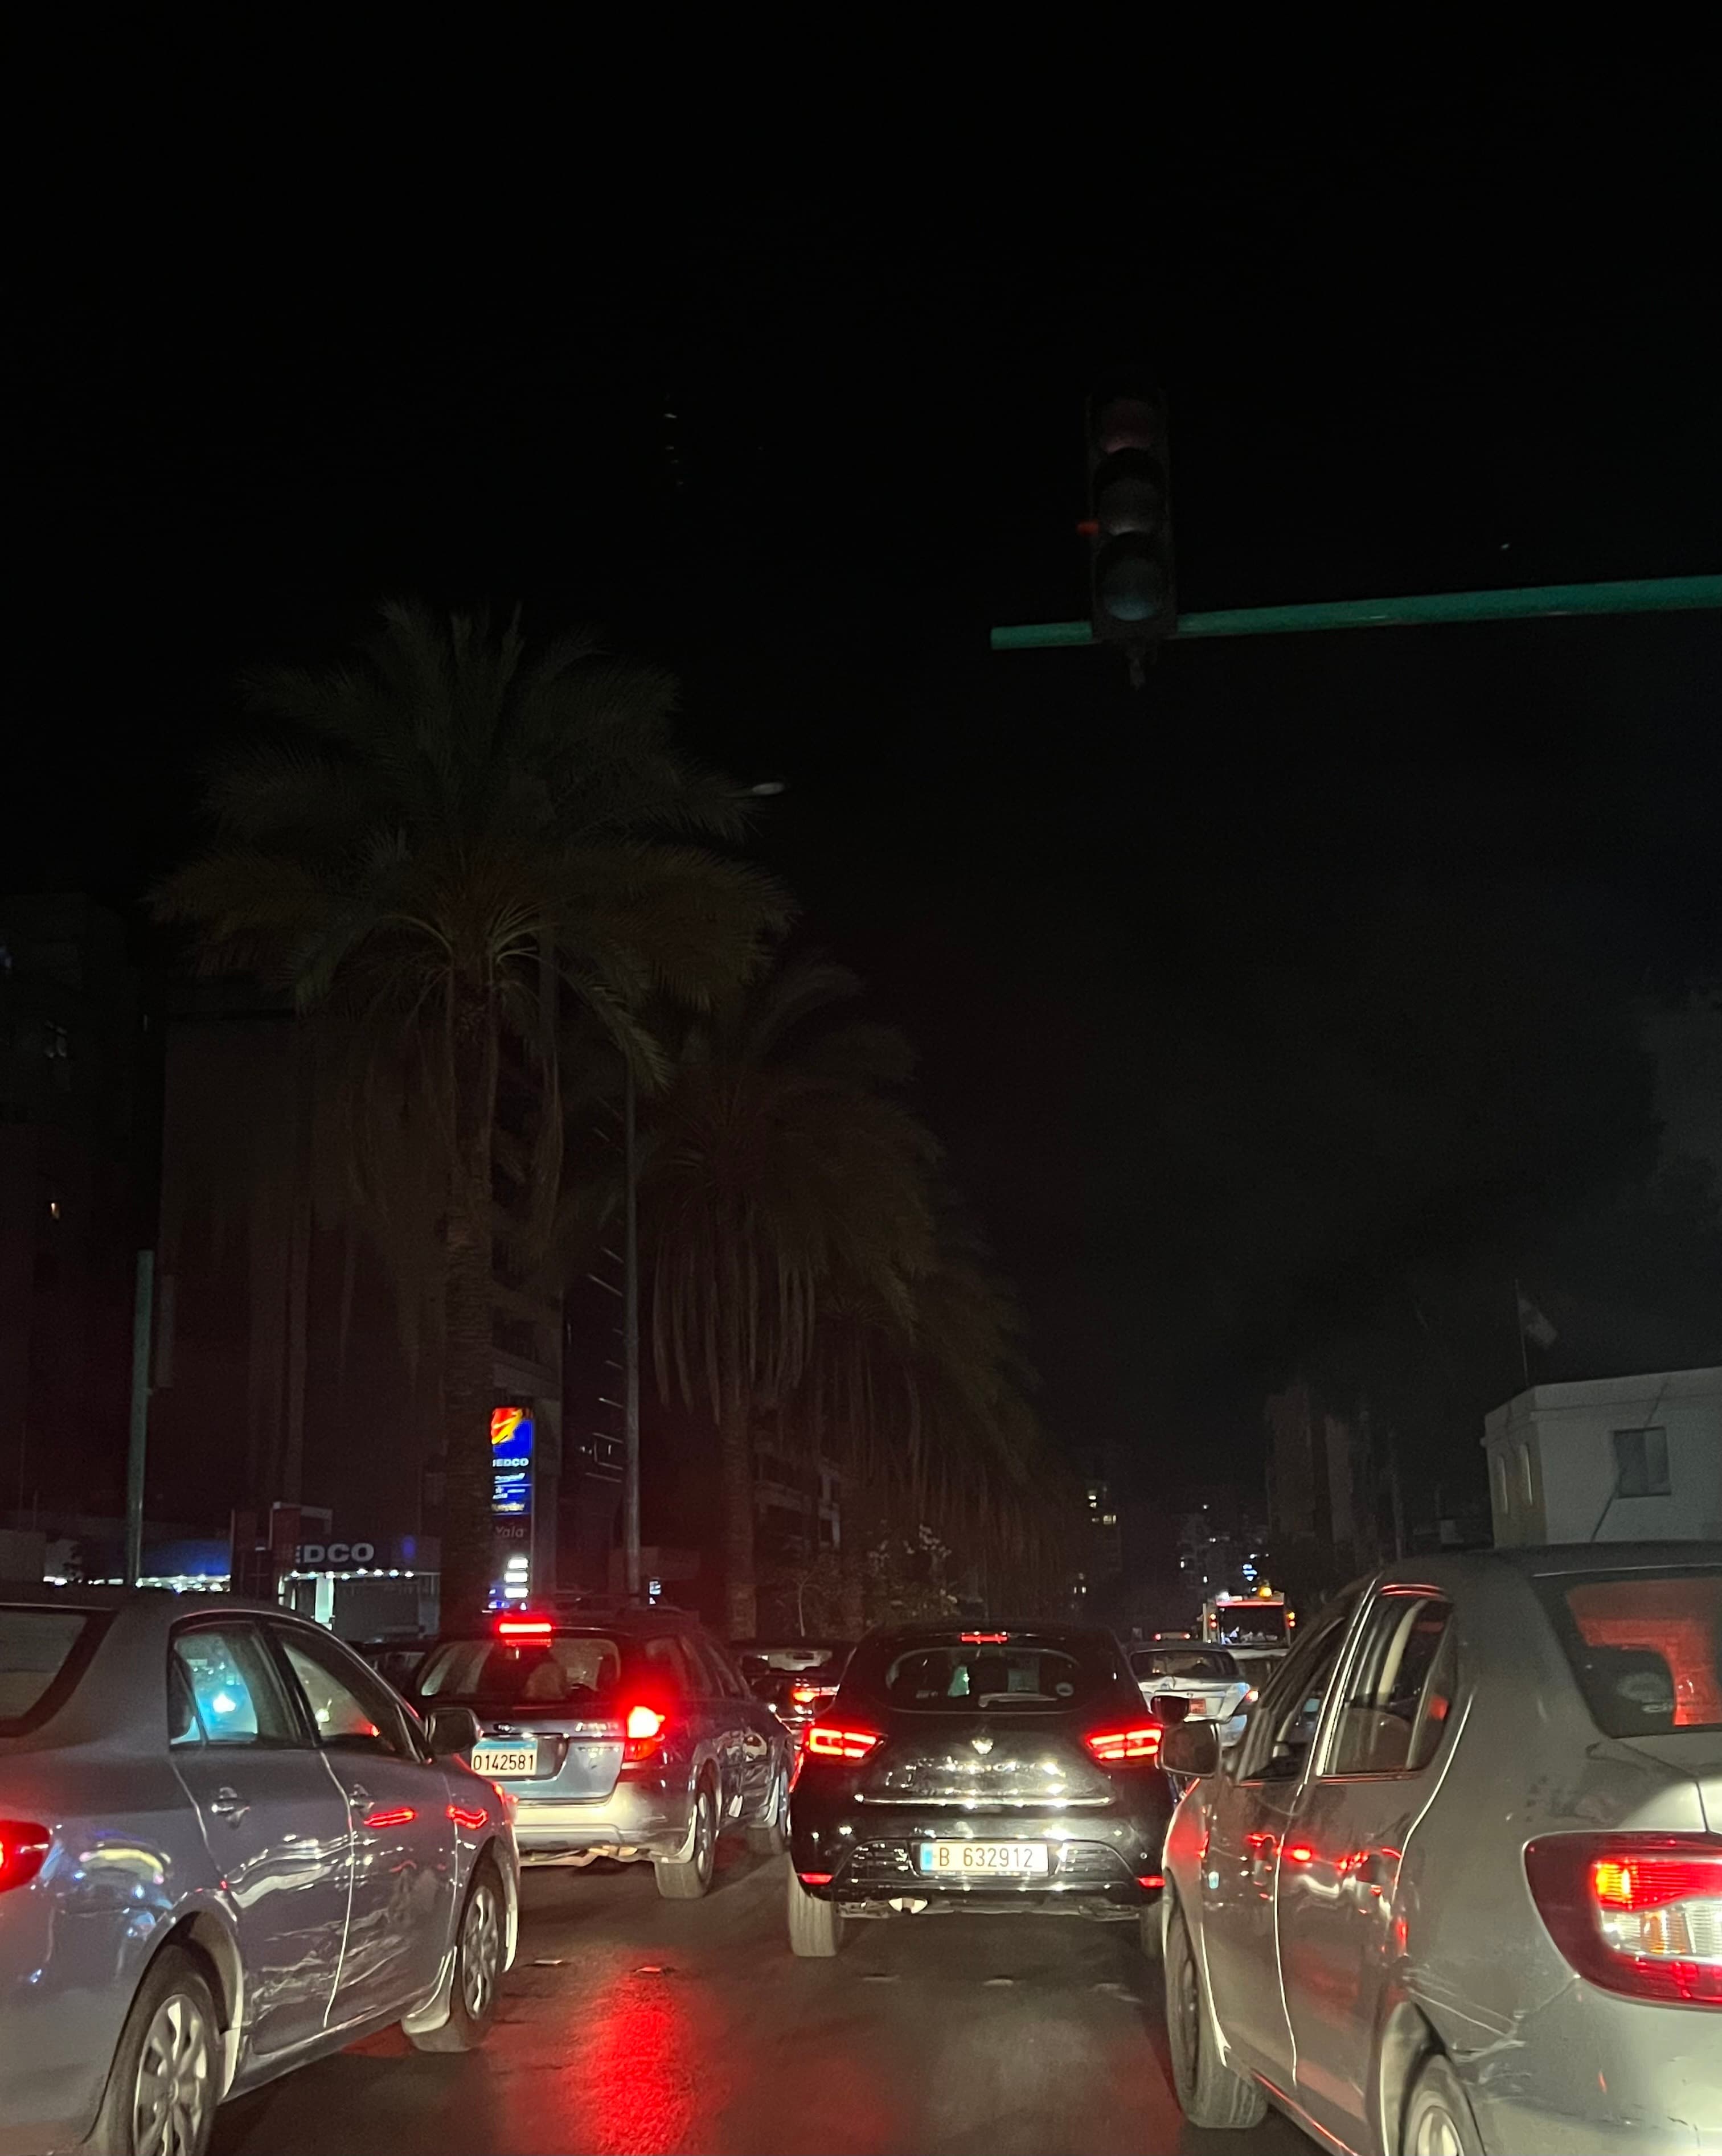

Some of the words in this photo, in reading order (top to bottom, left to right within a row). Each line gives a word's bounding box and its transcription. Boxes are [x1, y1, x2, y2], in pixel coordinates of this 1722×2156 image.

[493, 1457, 529, 1467] EDCO
[939, 1847, 950, 1867] B
[963, 1847, 1033, 1868] 632912
